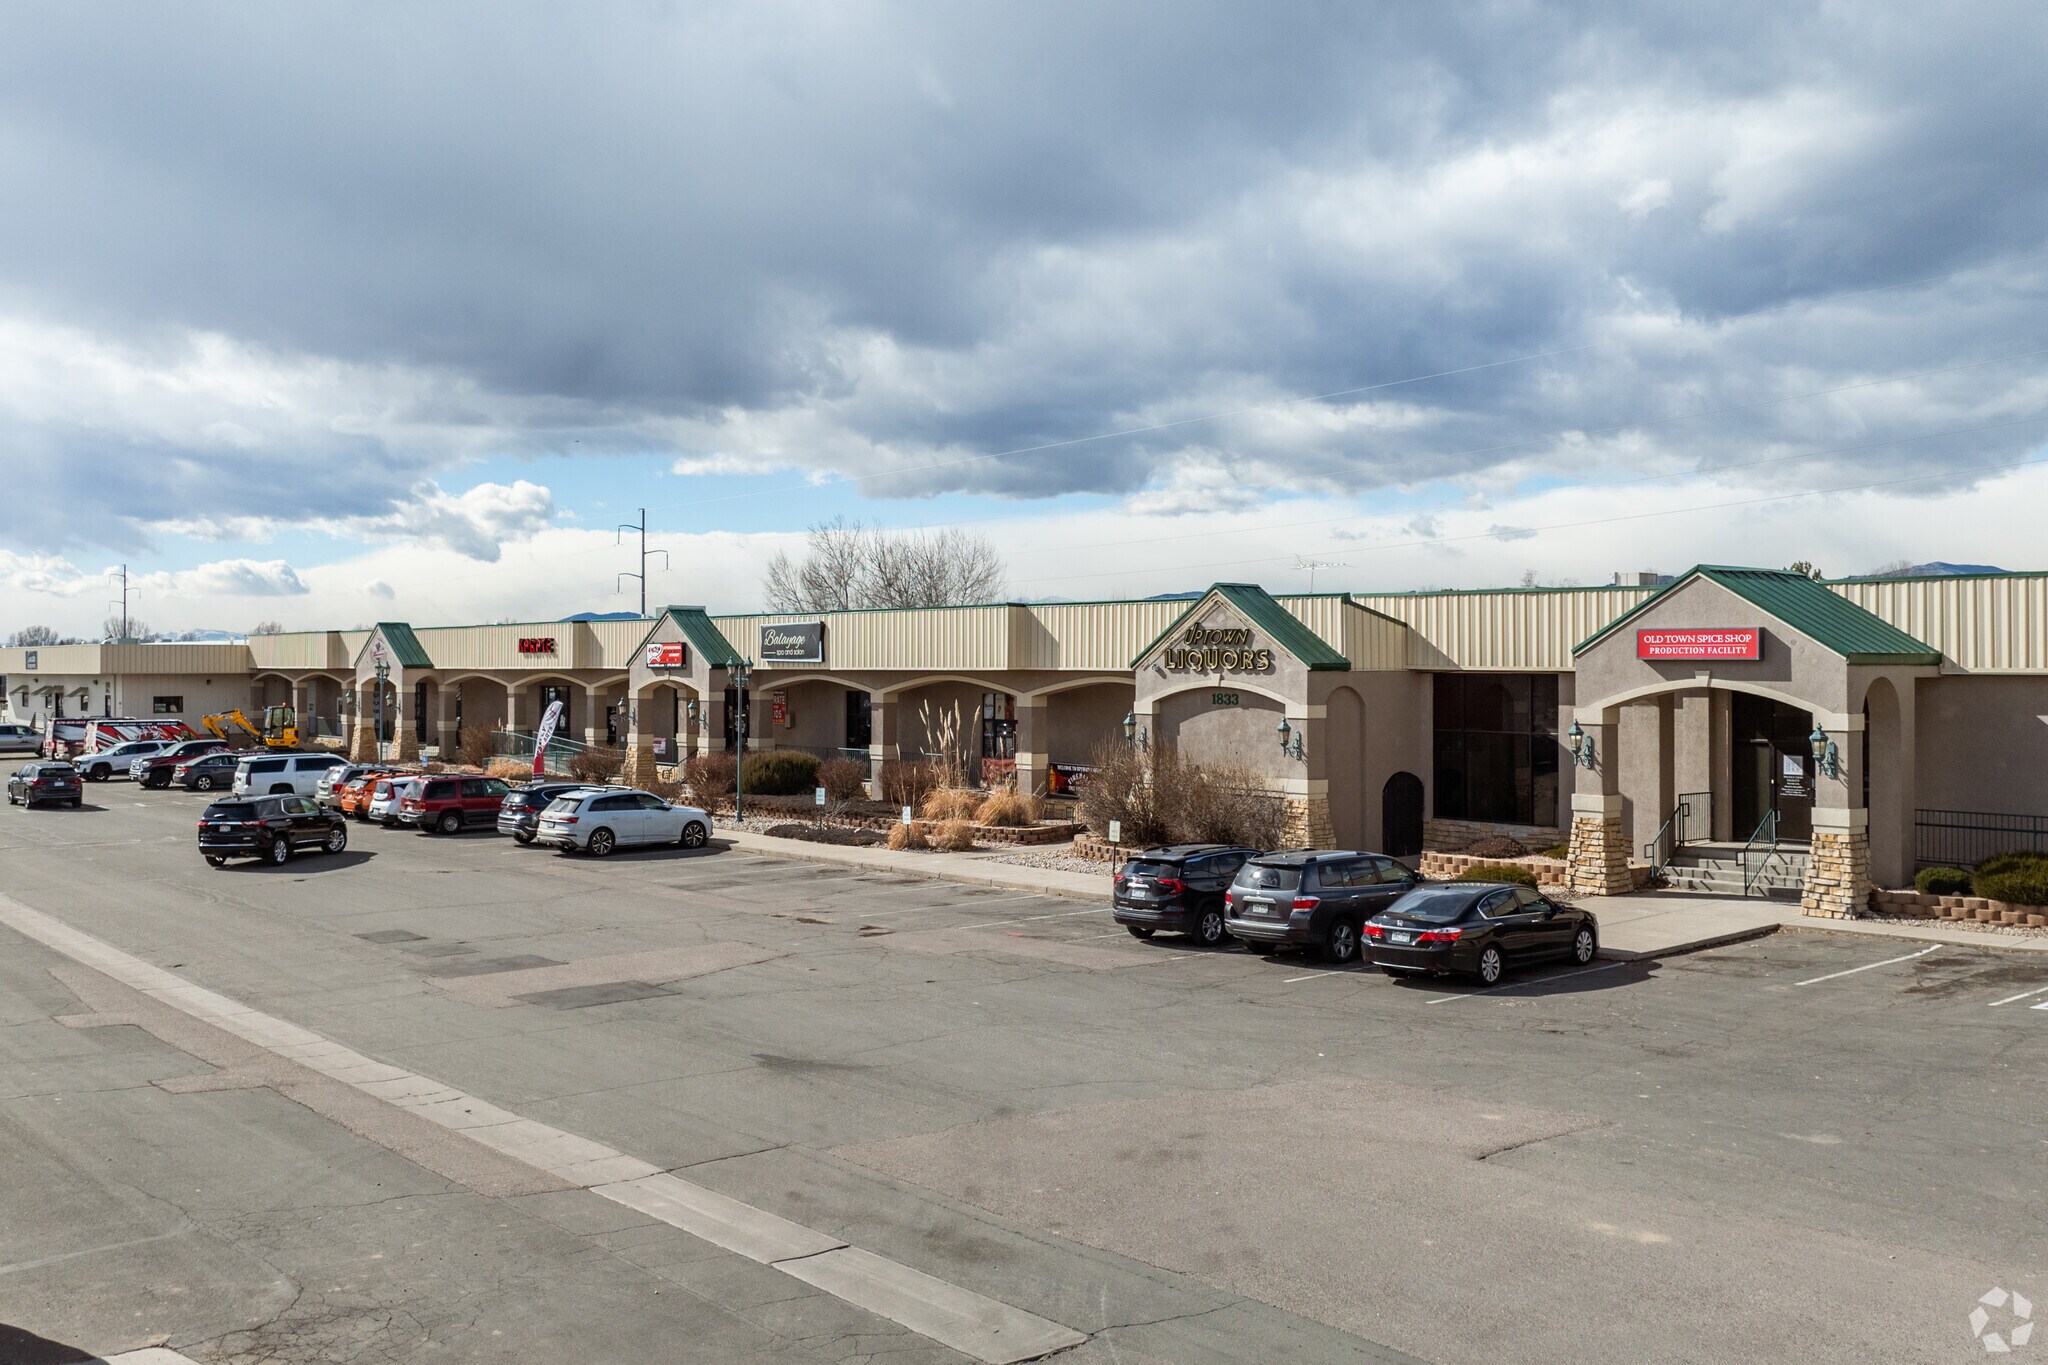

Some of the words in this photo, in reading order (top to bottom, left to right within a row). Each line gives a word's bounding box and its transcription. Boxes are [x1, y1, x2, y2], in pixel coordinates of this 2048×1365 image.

[764, 629, 806, 649] Balayage
[1184, 622, 1249, 645] UPTOWN
[1643, 635, 1664, 643] OLD
[1665, 635, 1696, 643] TOWN
[1697, 634, 1723, 643] SPICE
[1725, 634, 1752, 643] SHOP
[519, 638, 555, 653] KARATE
[1707, 646, 1748, 654] FACILITY
[1165, 648, 1270, 671] LIQUORS
[1212, 693, 1239, 705] 1833
